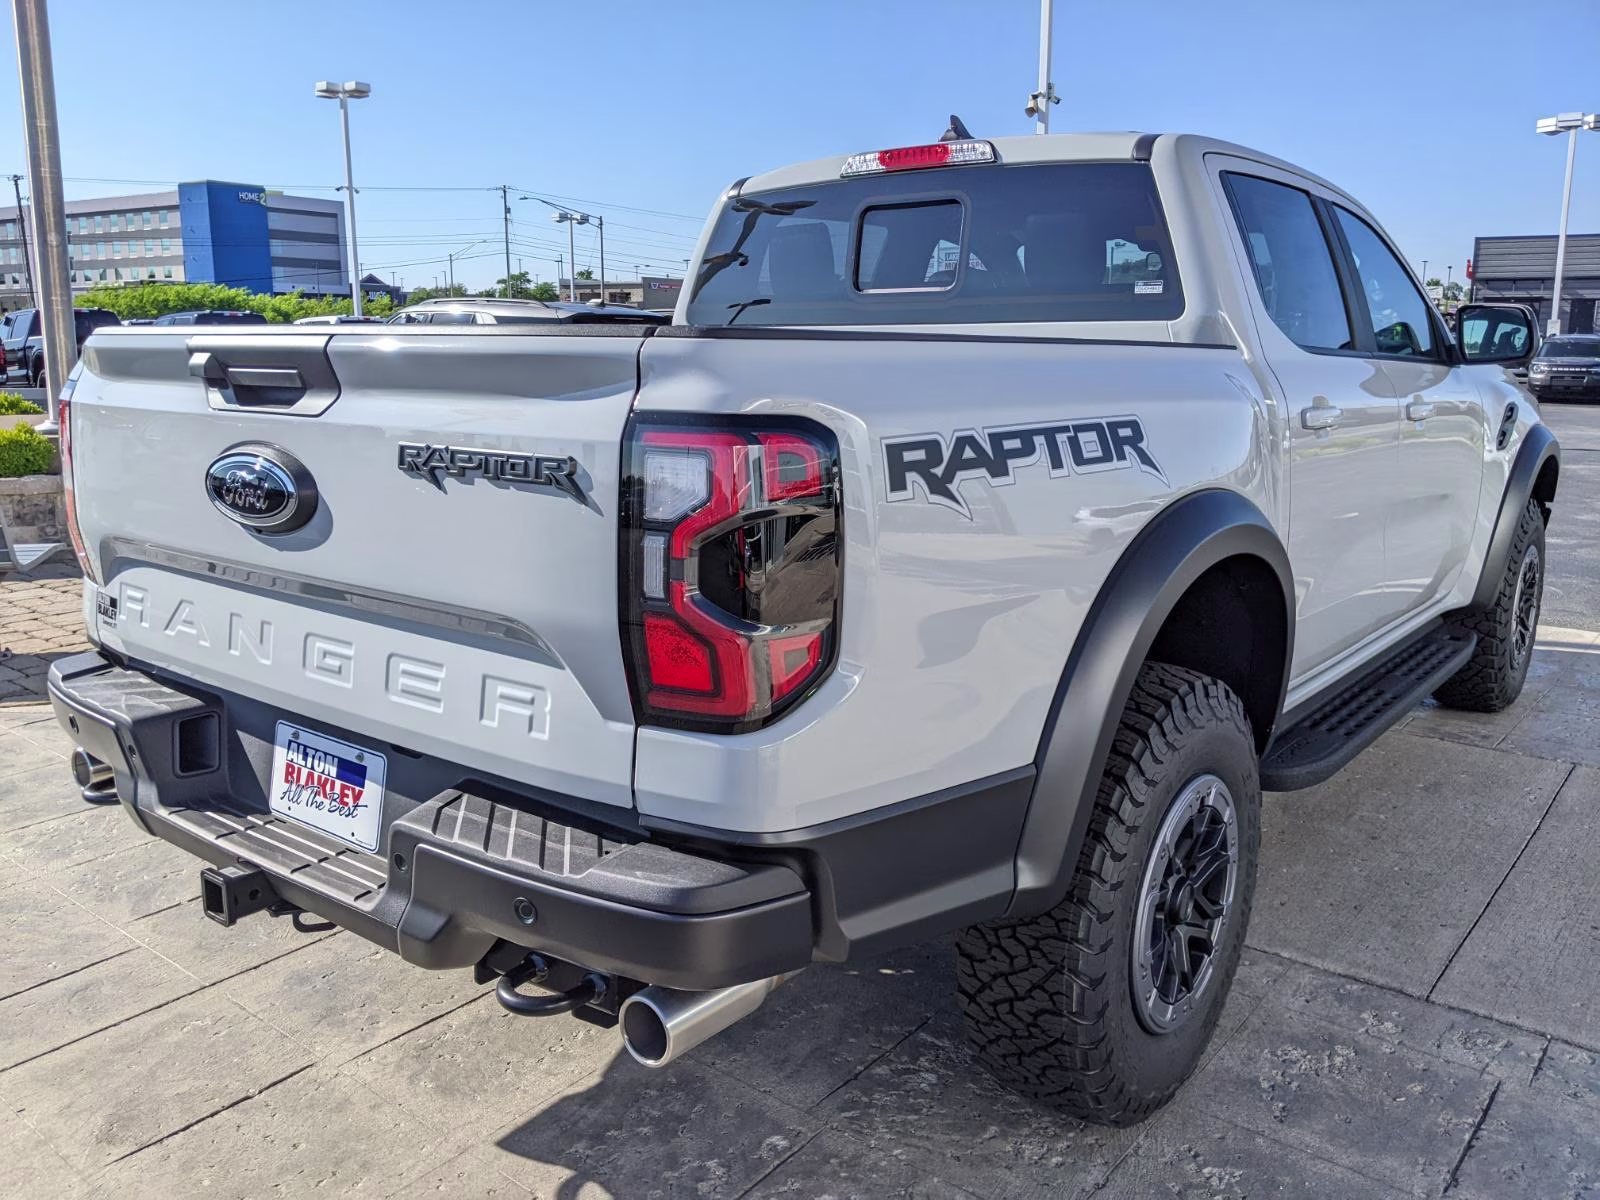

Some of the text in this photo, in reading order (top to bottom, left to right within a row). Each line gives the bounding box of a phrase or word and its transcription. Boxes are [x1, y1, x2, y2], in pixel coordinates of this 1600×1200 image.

[222, 468, 270, 510] Ford
[397, 440, 592, 508] RAPTOR
[881, 414, 1170, 520] RAPTOR
[118, 581, 551, 740] RANGER
[286, 740, 339, 778] ALTON
[280, 779, 368, 819] All The Best
[283, 761, 365, 808] BLAKLEY
